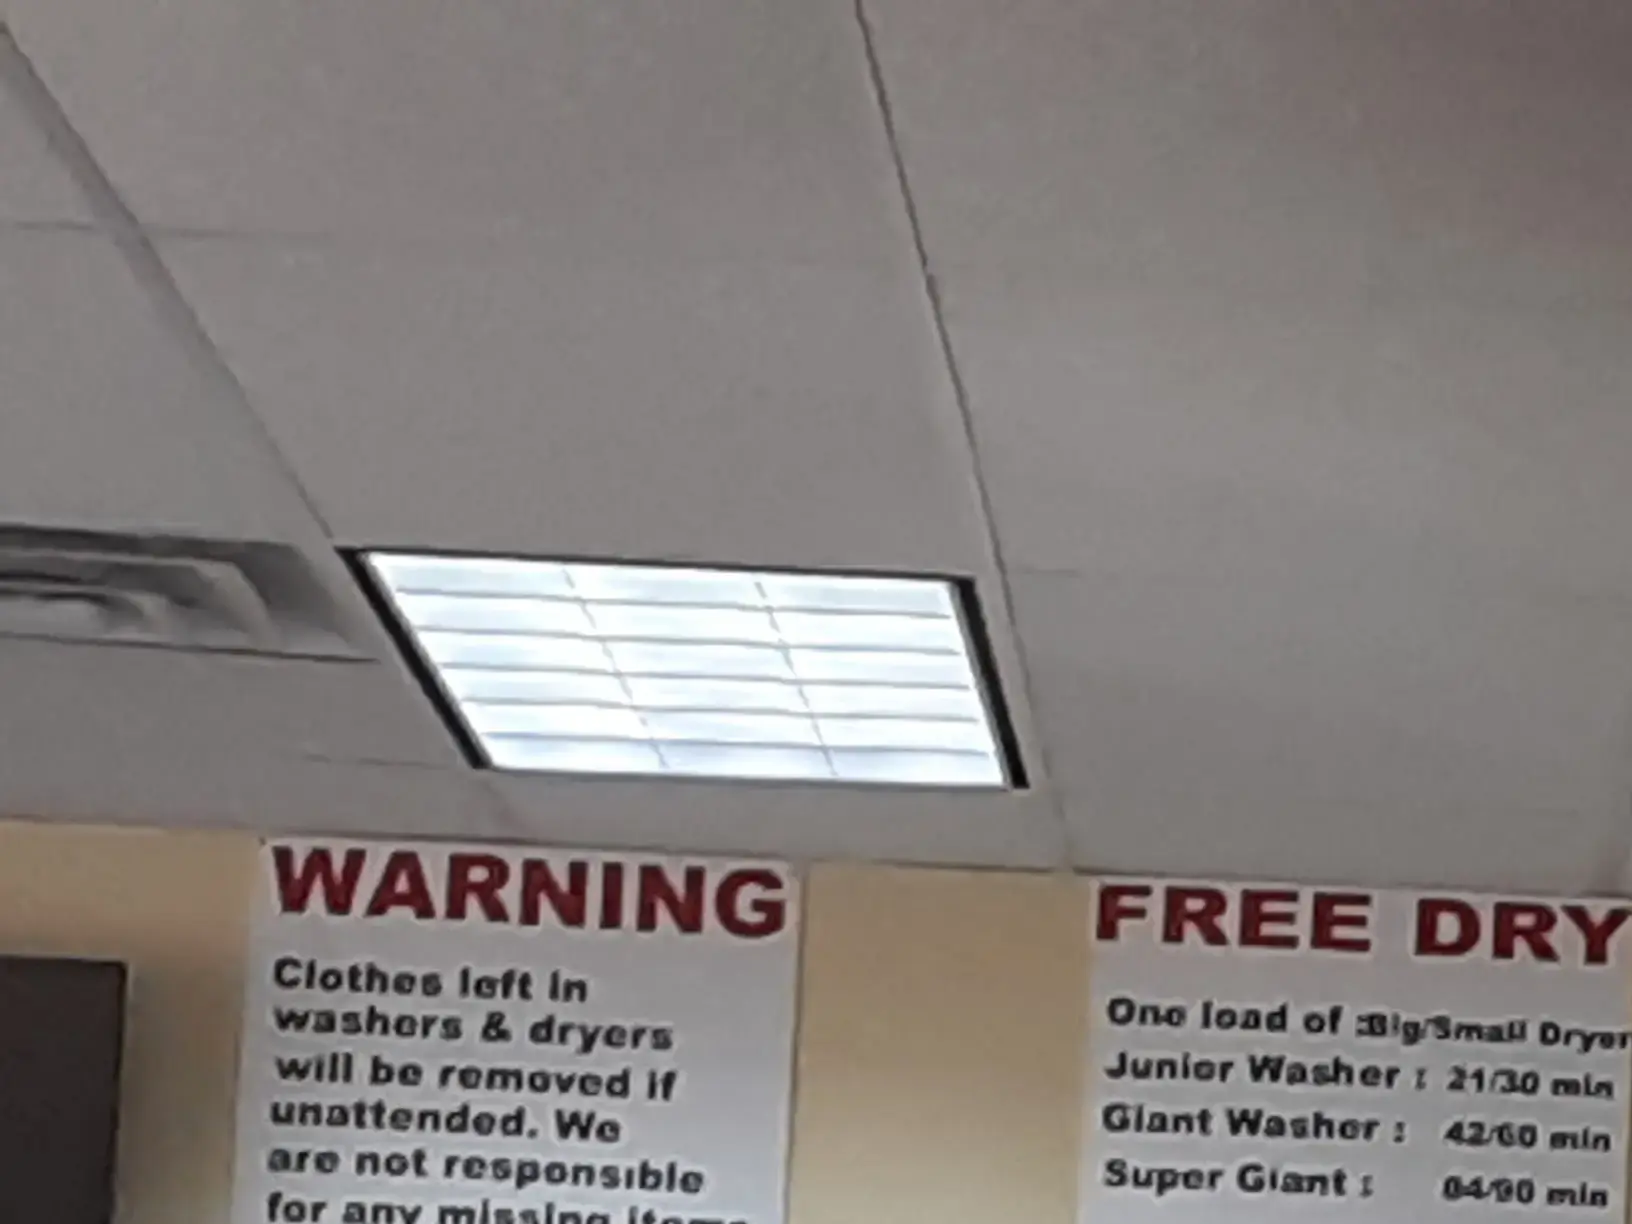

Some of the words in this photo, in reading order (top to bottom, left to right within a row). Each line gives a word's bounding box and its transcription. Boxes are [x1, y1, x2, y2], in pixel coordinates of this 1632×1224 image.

[272, 846, 787, 938] WARNING
[1097, 885, 1372, 952] FREE
[272, 958, 442, 997] Clothes
[460, 967, 533, 1000] left
[549, 970, 588, 1003] in
[274, 1006, 462, 1041] washers
[481, 1012, 512, 1043] &
[530, 1015, 674, 1053] dryers
[1108, 998, 1187, 1027] One
[1202, 1001, 1287, 1032] load
[1305, 1007, 1343, 1034] of
[1539, 1021, 1632, 1054] Dryer
[276, 1053, 354, 1084] will
[370, 1056, 422, 1087] be
[439, 1064, 630, 1099] removed
[647, 1069, 677, 1101] if
[1105, 1051, 1234, 1083] Junior
[1248, 1055, 1400, 1089] Washer
[1447, 1064, 1541, 1096] 21/30
[1551, 1072, 1615, 1100] min
[270, 1099, 539, 1138] unattended.
[555, 1109, 621, 1143] We
[1103, 1103, 1213, 1135] Giant
[1227, 1107, 1380, 1142] Washer
[1550, 1126, 1612, 1152] min
[268, 1149, 340, 1174] are
[356, 1149, 426, 1177] not
[444, 1154, 704, 1194] responsible
[1104, 1158, 1224, 1193] Super
[1237, 1163, 1347, 1195] Giant
[1545, 1182, 1608, 1208] min
[267, 1193, 328, 1223] for
